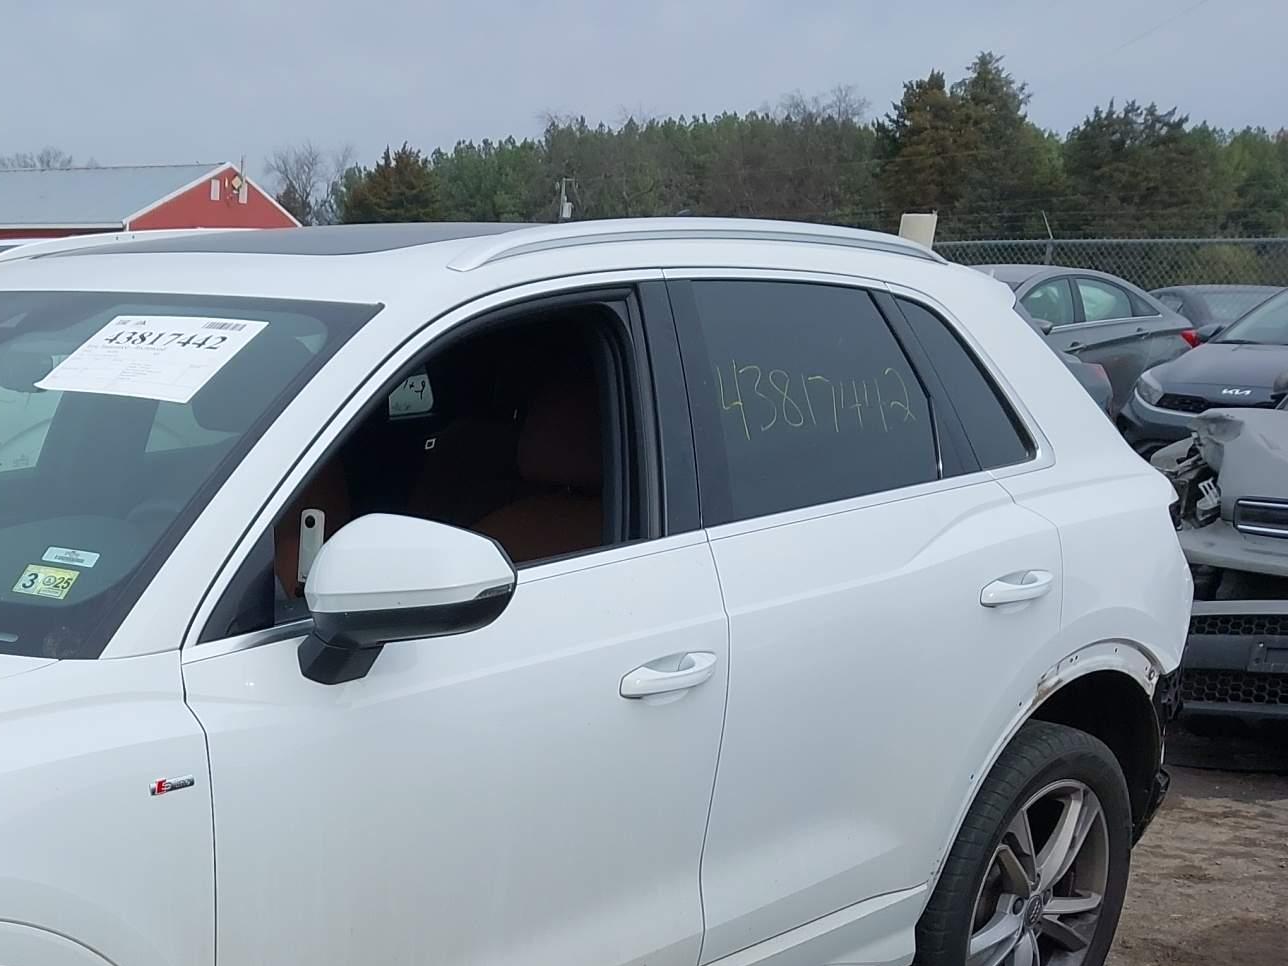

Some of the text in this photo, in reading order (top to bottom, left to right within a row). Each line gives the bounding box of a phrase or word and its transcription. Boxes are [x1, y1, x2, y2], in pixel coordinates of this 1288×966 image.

[104, 330, 227, 350] 43817442
[716, 359, 917, 441] 43817442
[22, 573, 73, 590] 3 25
